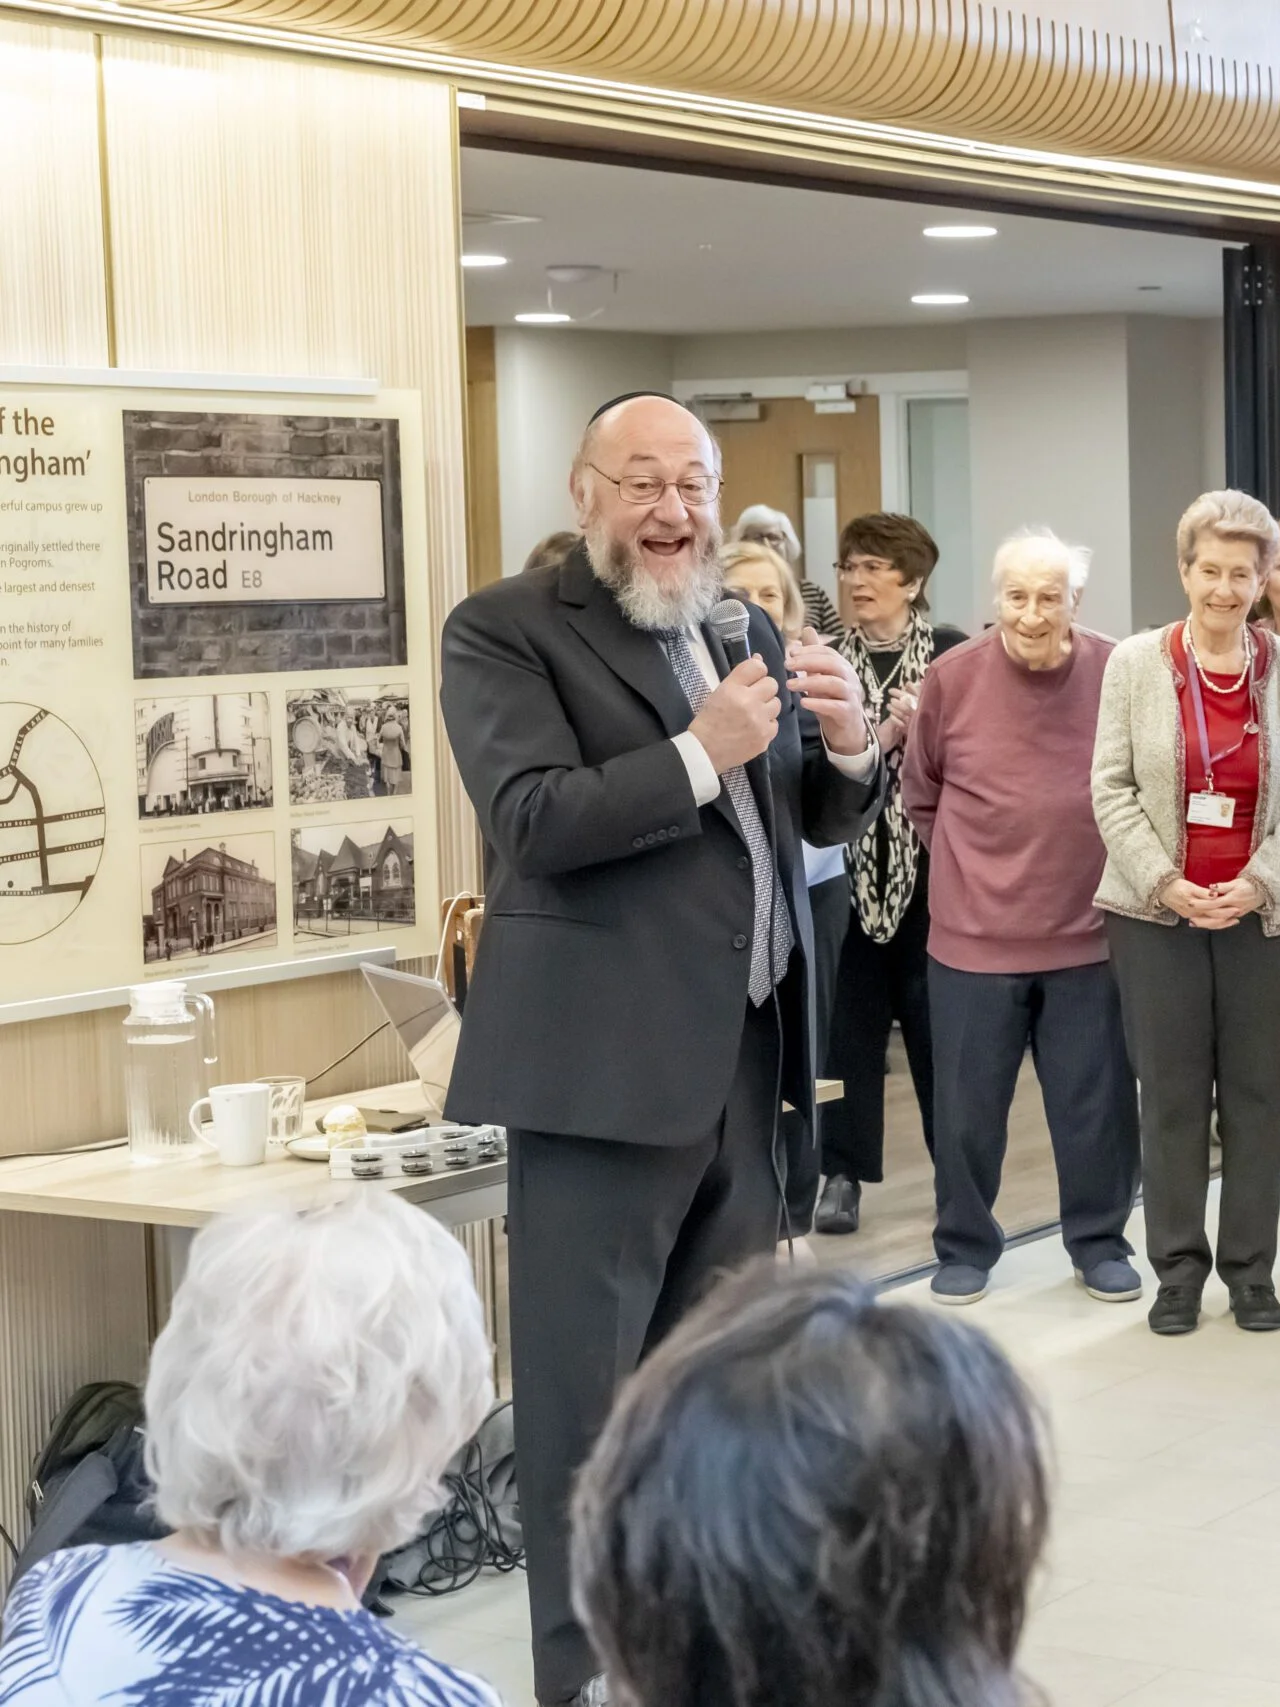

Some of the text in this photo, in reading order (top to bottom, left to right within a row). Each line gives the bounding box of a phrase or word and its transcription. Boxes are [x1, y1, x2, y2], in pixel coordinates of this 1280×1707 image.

[12, 407, 55, 436] the
[188, 490, 342, 505] London Borough of Hackney
[25, 502, 62, 514] campus
[64, 503, 88, 514] grew
[90, 503, 103, 515] up
[157, 521, 333, 557] Sandringham
[0, 540, 101, 555] riginally settled there
[9, 557, 54, 570] Pogroms.
[157, 560, 263, 591] Road E8
[4, 582, 37, 595] largest
[39, 581, 57, 592] and
[59, 581, 96, 592] densest
[8, 622, 25, 634] the
[26, 621, 60, 634] history
[61, 620, 72, 632] of
[24, 637, 38, 650] for
[39, 640, 67, 651] many
[68, 636, 104, 648] families
